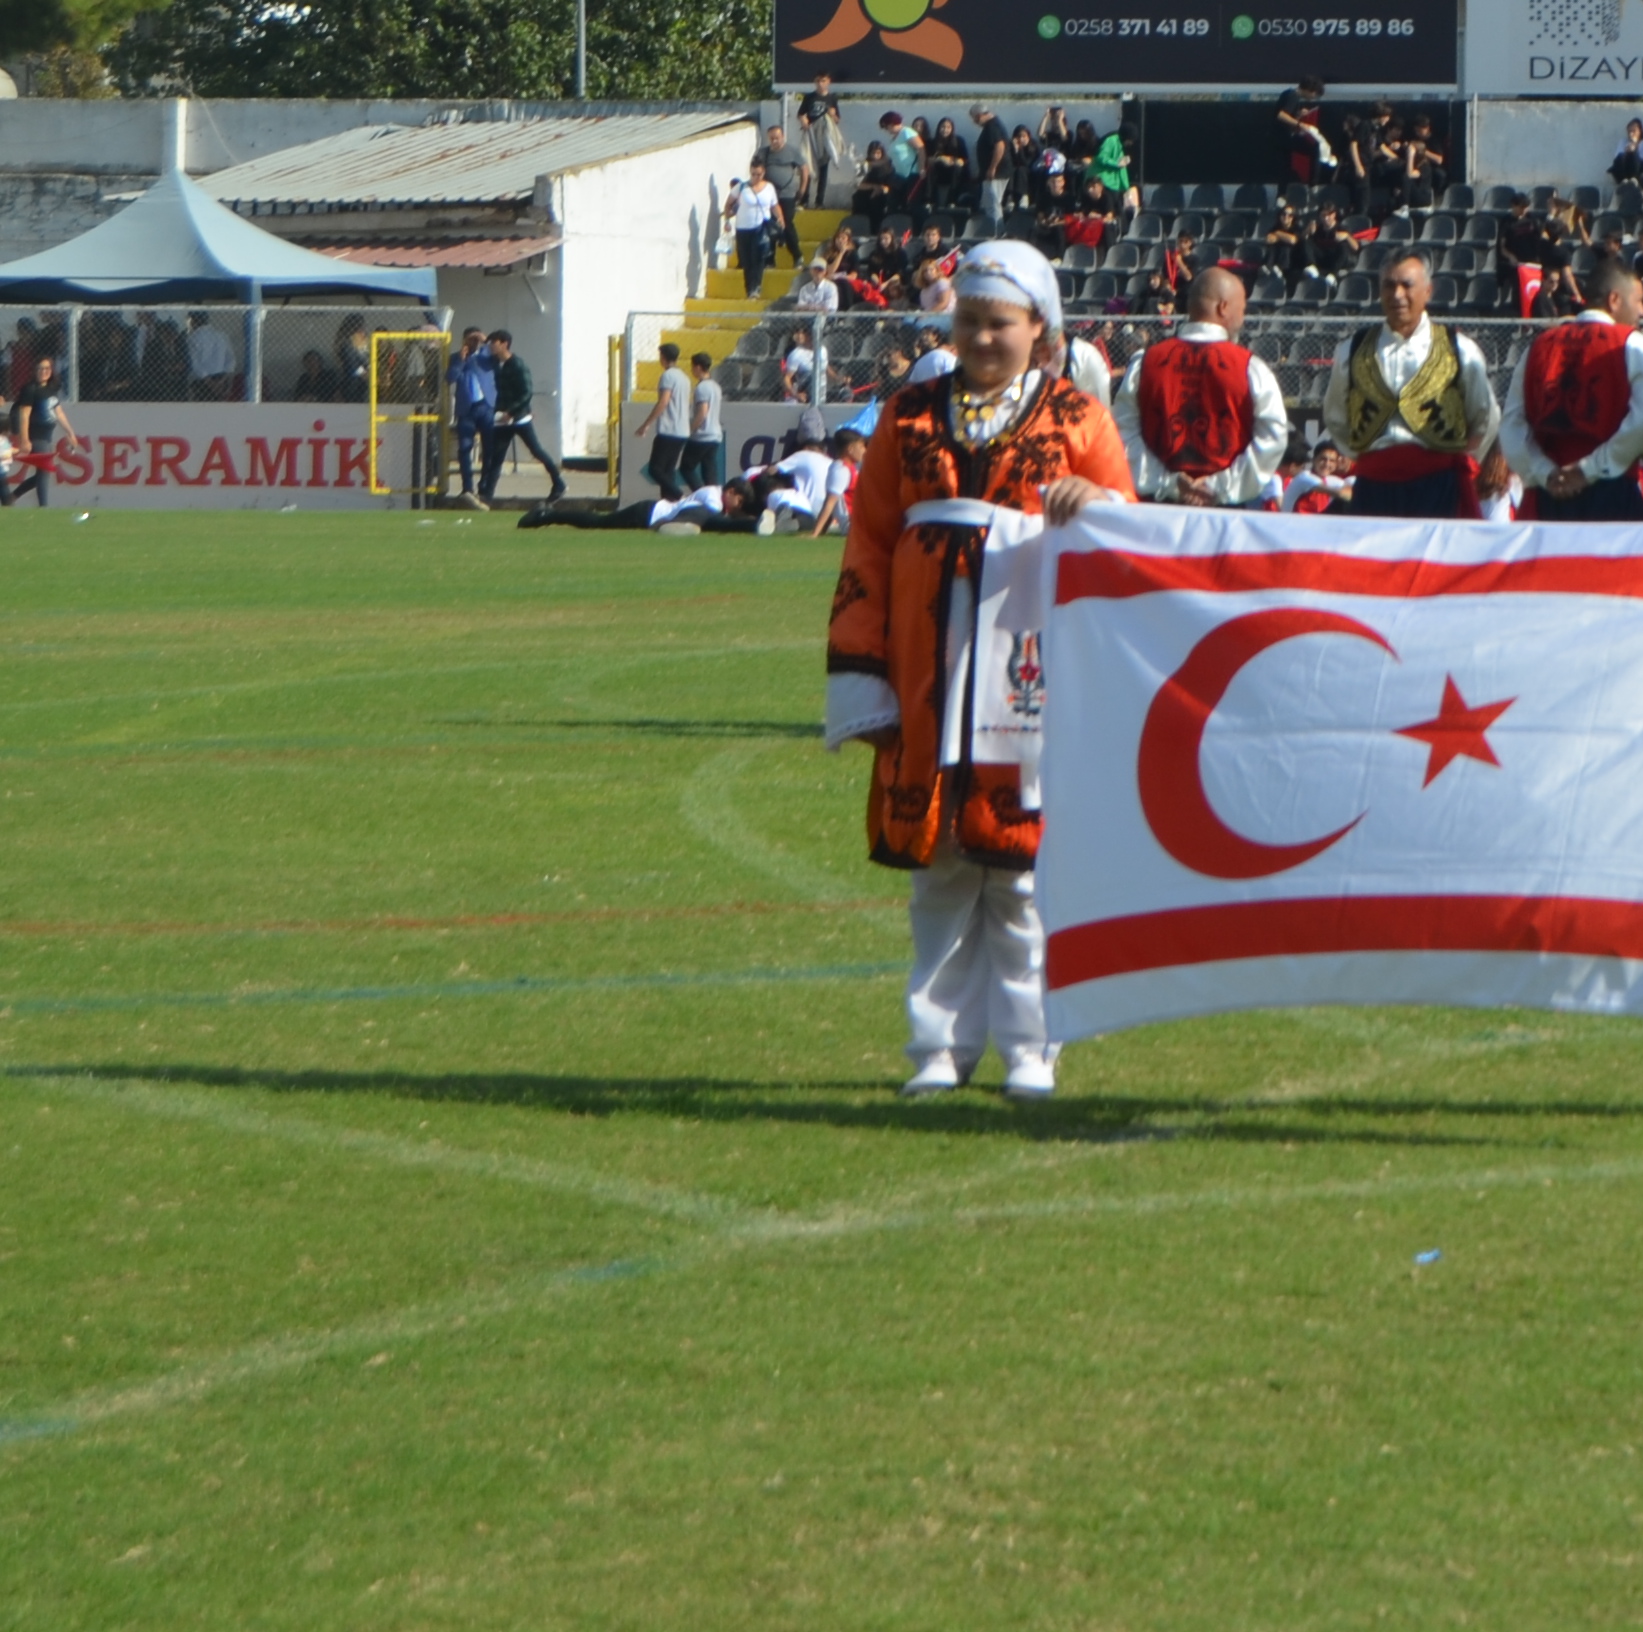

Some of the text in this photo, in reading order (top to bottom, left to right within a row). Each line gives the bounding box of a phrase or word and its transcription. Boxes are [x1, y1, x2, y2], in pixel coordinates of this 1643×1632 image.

[1064, 18, 1210, 36] 0258 371 41 89
[1257, 18, 1415, 36] 0530 975 89 86
[56, 418, 386, 488] SERAMİK
